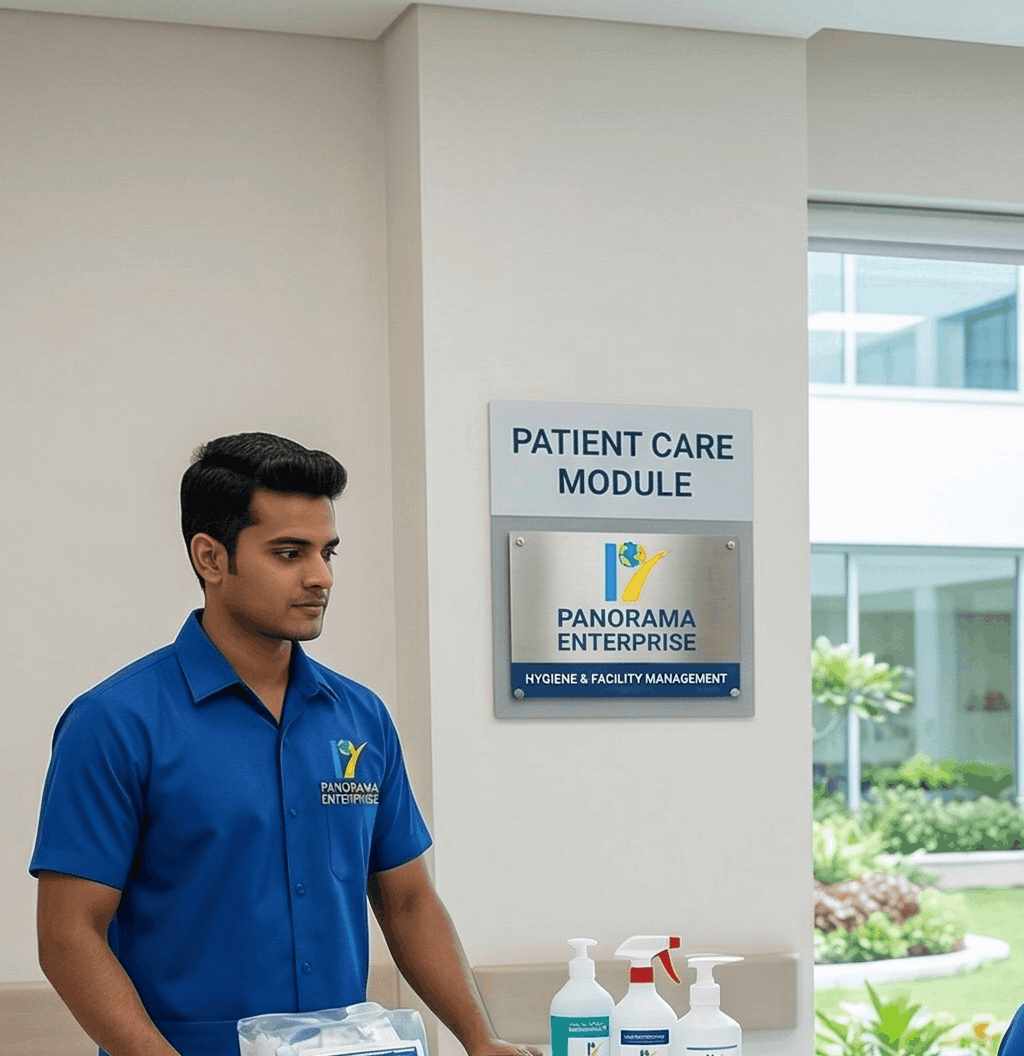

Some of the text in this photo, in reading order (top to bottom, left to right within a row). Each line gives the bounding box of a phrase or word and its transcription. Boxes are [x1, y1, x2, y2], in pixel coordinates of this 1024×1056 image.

[513, 427, 734, 460] PATIENT CARE
[558, 468, 693, 498] MODULE
[557, 608, 697, 628] PANORAMA
[557, 633, 697, 651] ENTERPRISE
[525, 673, 728, 685] HYGIENE & FACILITY MANAGEMENT
